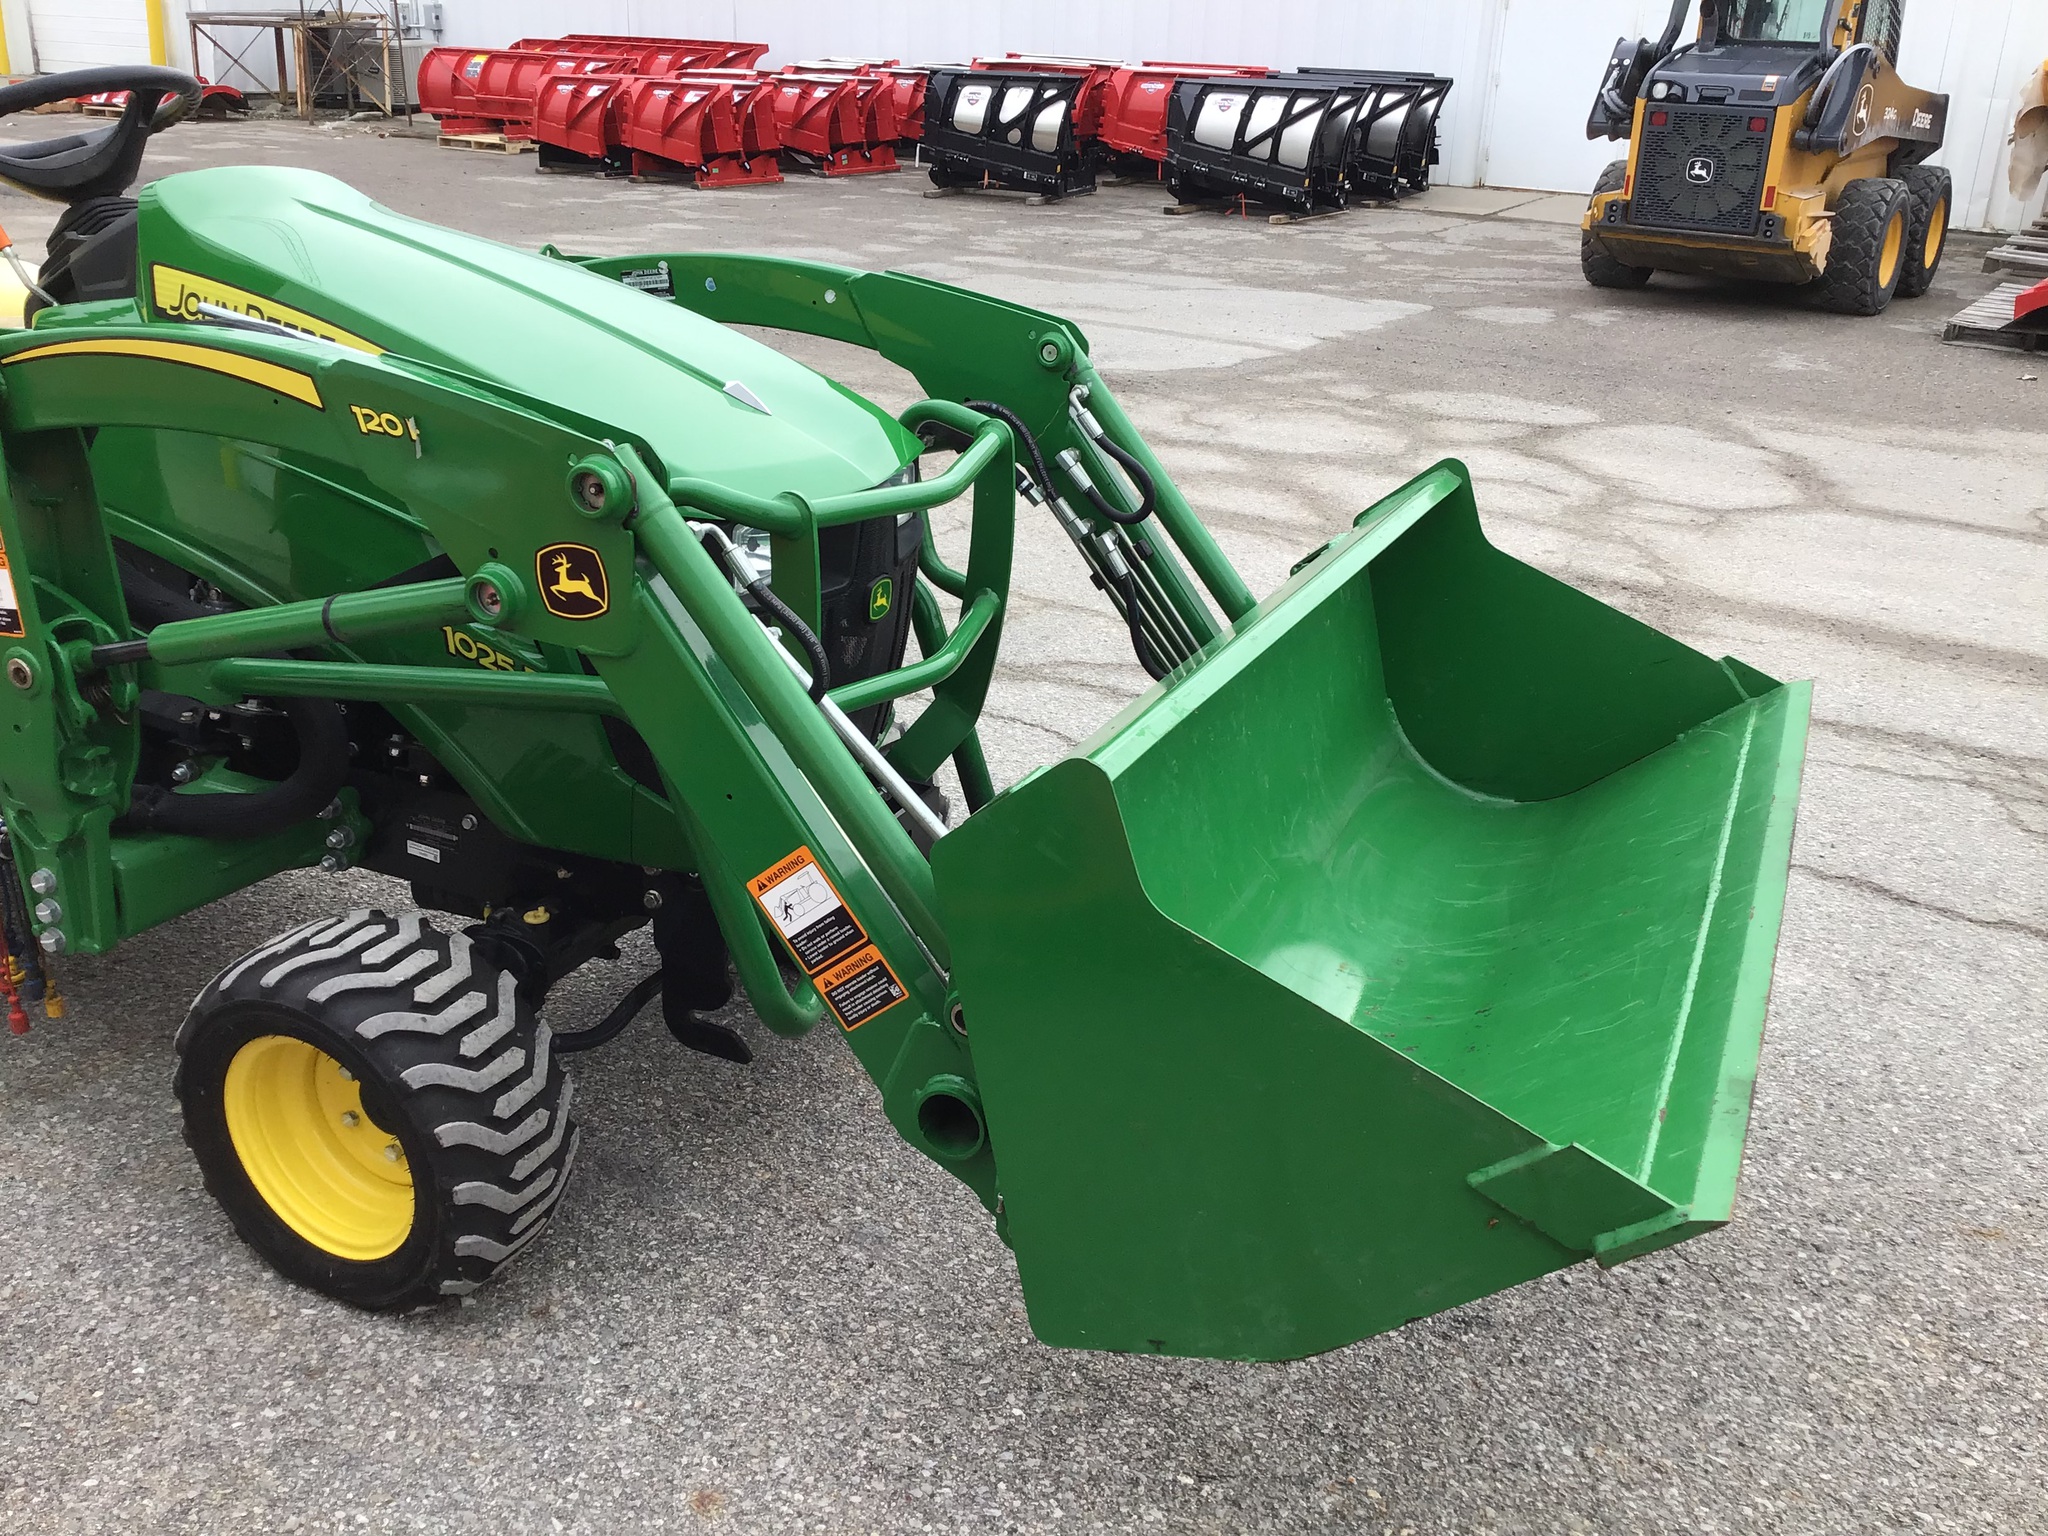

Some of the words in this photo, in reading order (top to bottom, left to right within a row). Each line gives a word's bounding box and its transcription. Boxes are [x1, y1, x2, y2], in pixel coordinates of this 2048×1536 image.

[1912, 108, 1933, 129] DEERE
[442, 625, 534, 672] 1025
[765, 854, 805, 885] WARNING
[833, 952, 873, 982] WARNING
